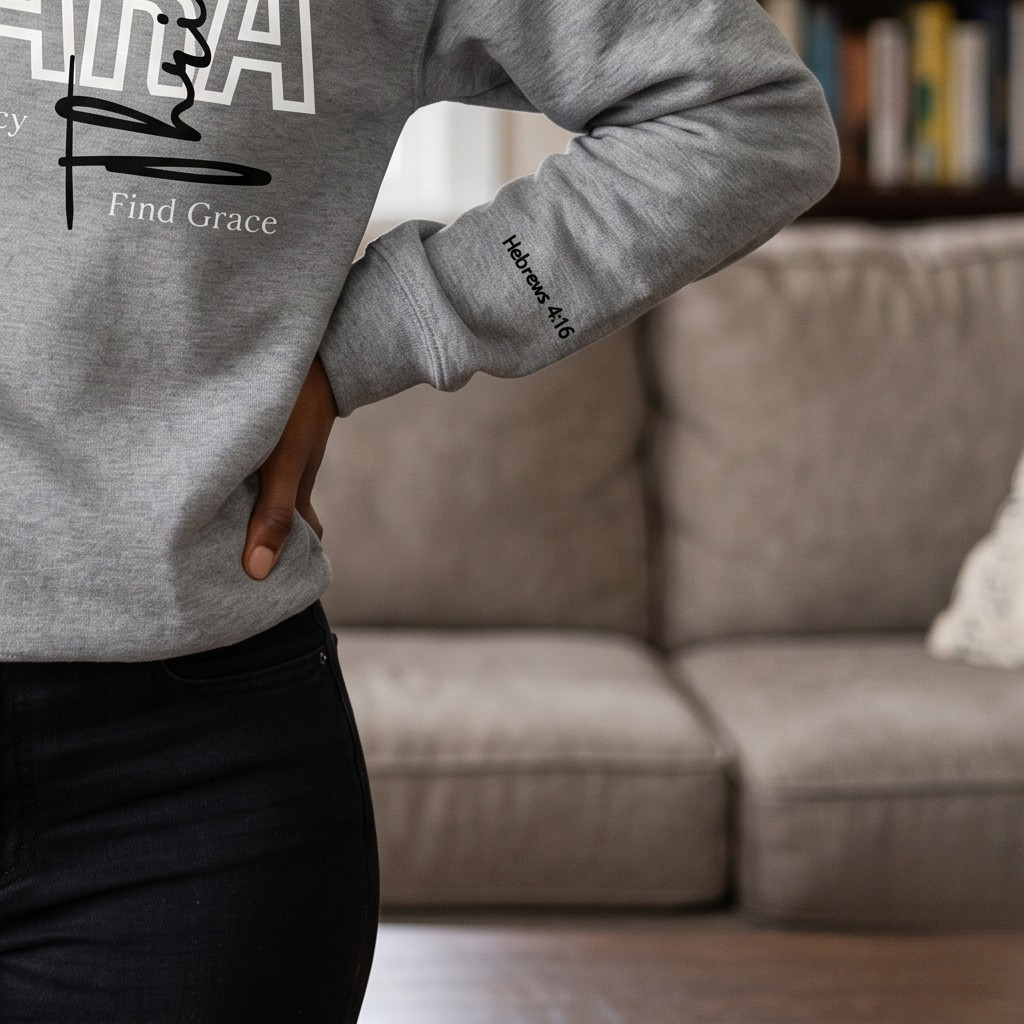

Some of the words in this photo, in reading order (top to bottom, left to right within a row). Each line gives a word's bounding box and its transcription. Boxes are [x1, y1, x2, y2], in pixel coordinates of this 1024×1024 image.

[107, 192, 175, 224] Find
[187, 201, 278, 234] Grace
[502, 234, 550, 305] Hebrews
[547, 306, 575, 339] 4:16
